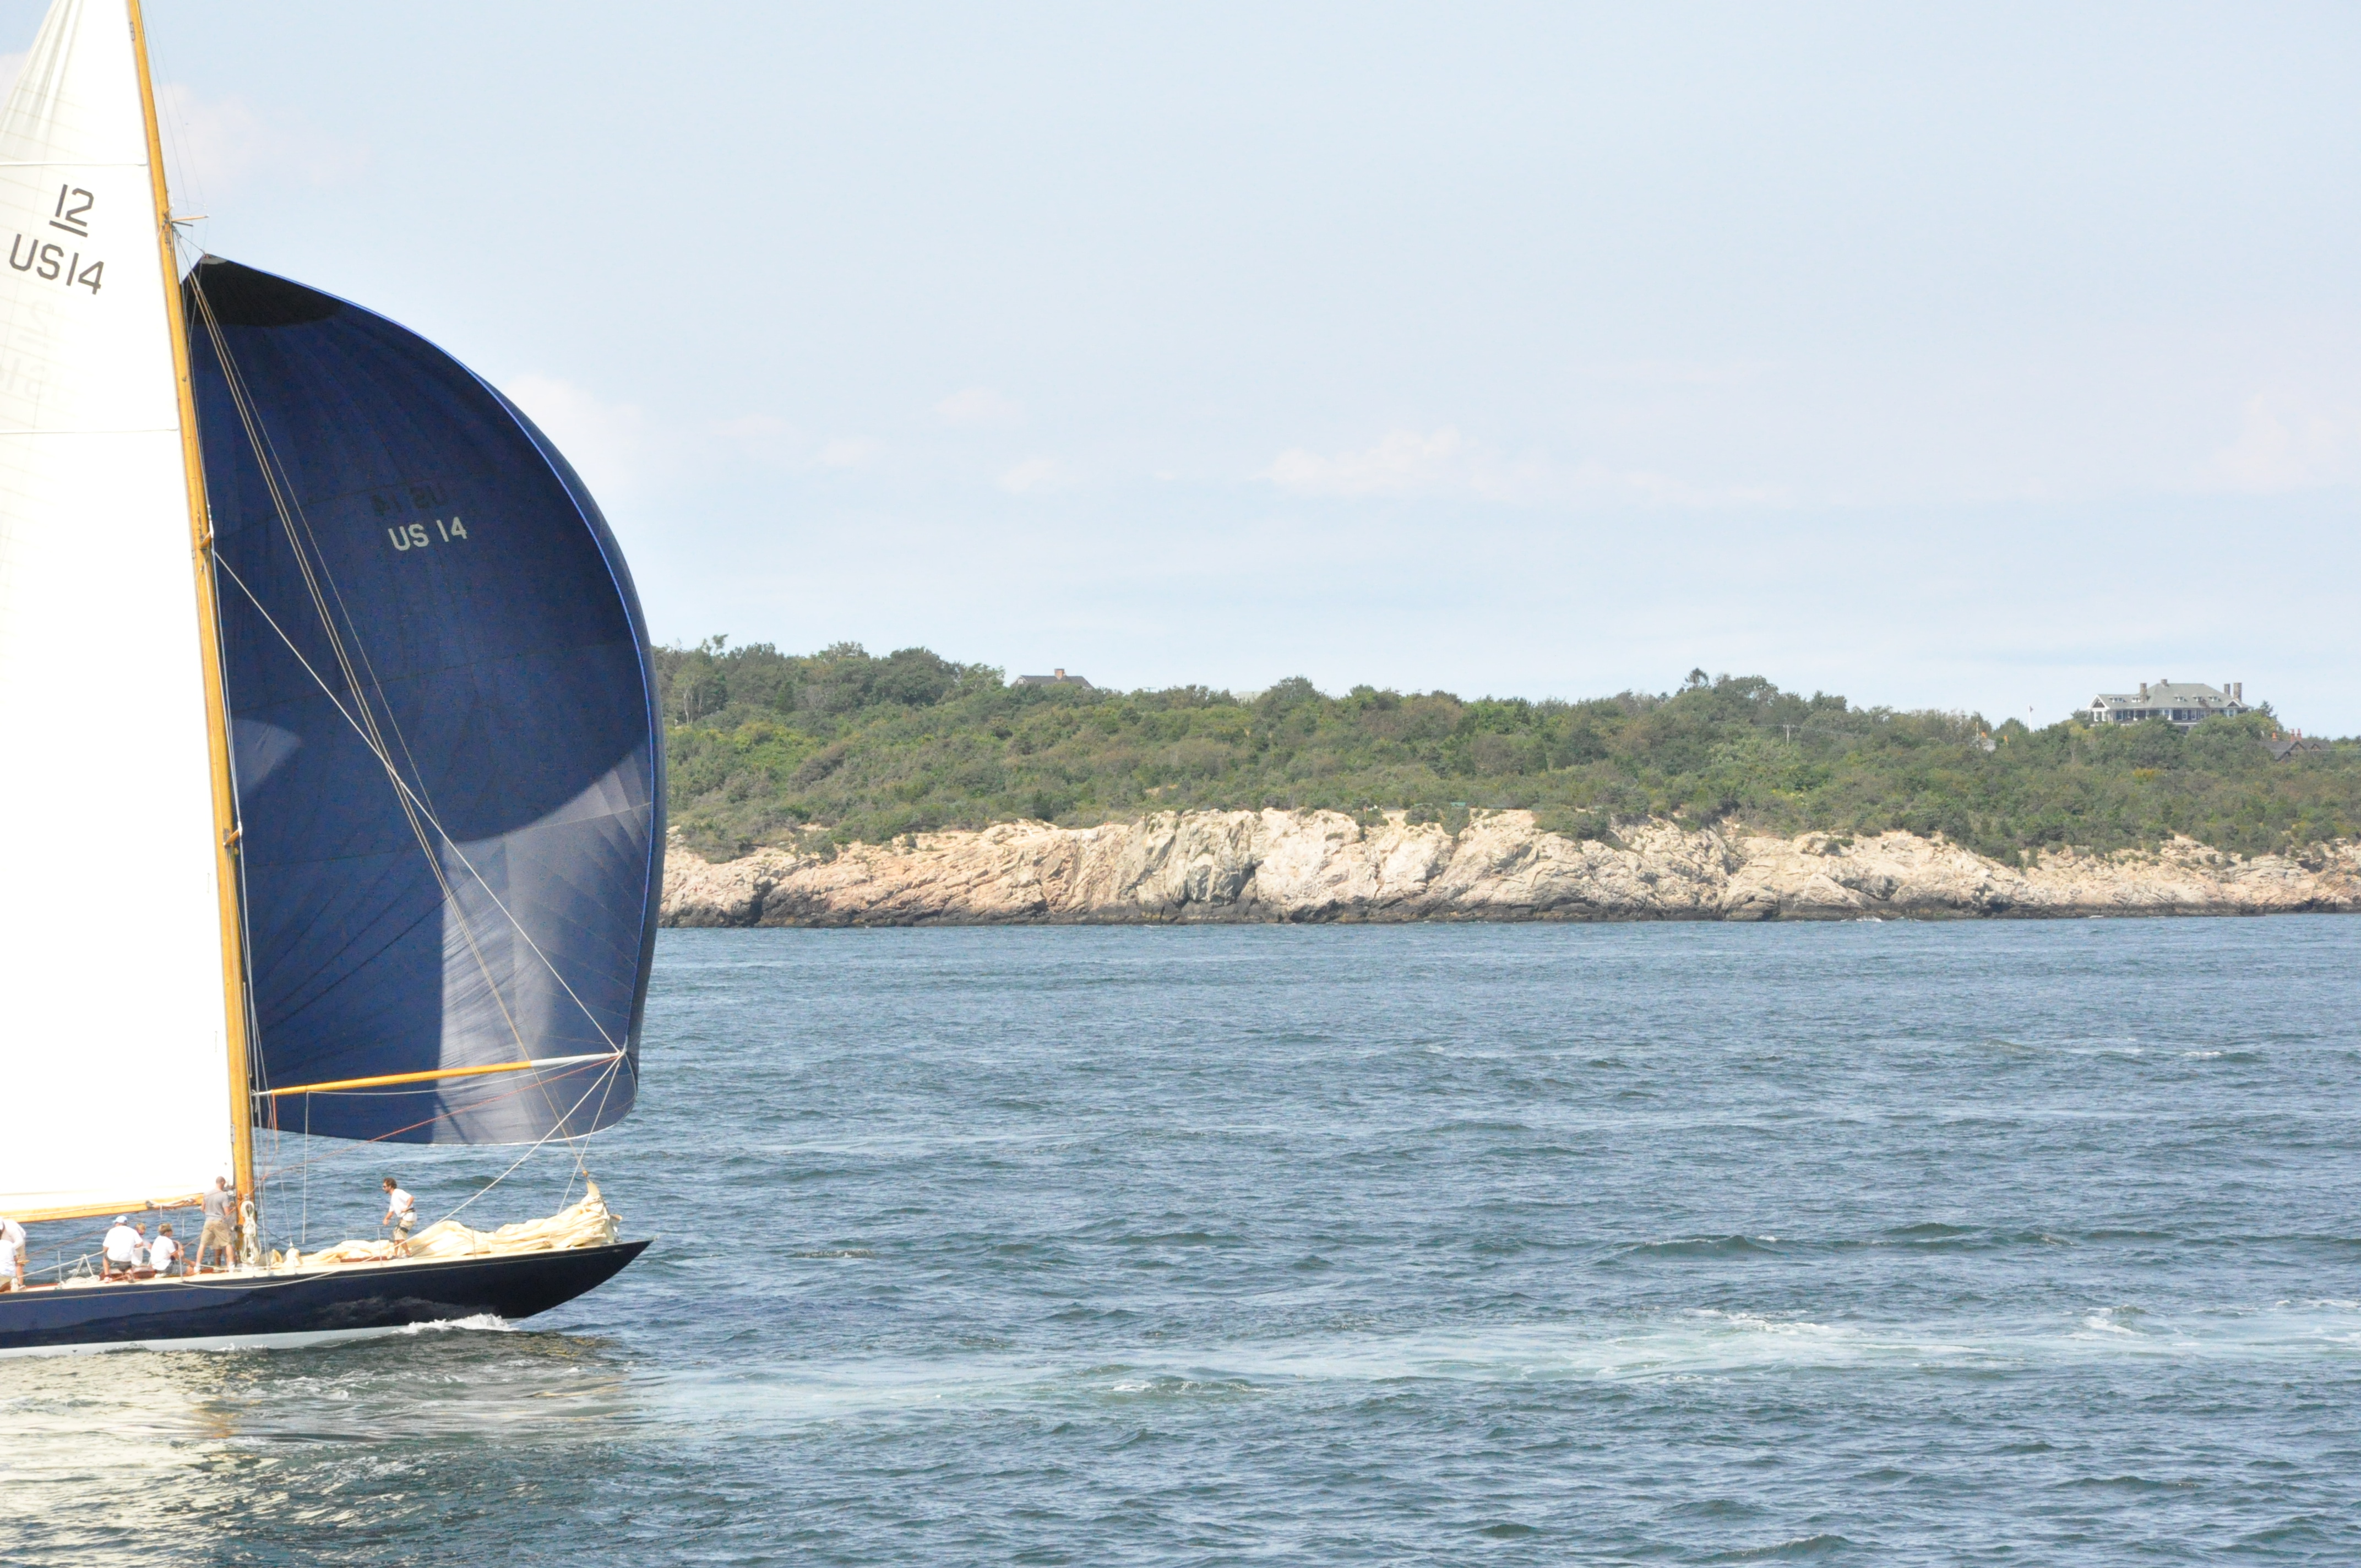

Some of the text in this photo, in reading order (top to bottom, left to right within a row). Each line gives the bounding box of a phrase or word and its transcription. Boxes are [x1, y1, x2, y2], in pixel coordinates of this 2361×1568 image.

[55, 184, 94, 227] 12
[388, 516, 467, 551] US 14
